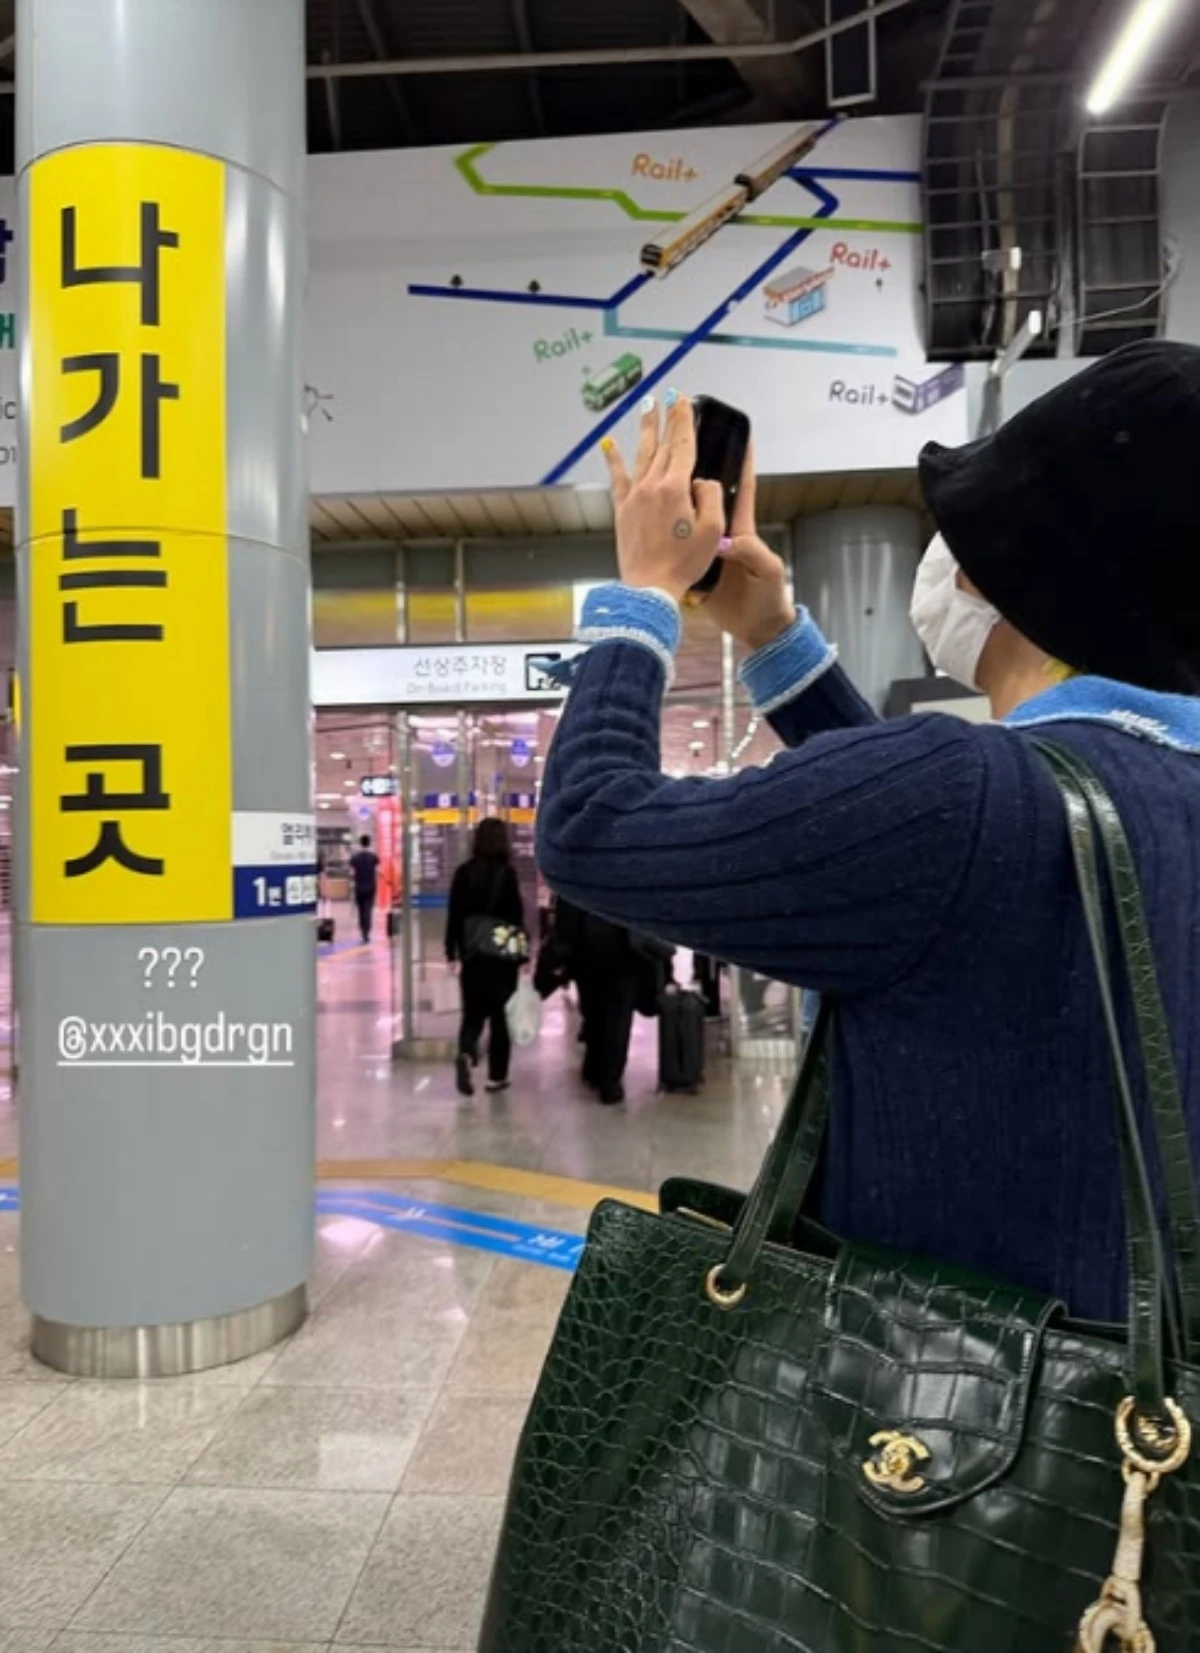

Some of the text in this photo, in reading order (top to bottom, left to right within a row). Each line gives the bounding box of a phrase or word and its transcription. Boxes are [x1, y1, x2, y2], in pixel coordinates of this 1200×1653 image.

[631, 152, 698, 184] Rail+
[830, 242, 892, 271] Rail+
[532, 326, 594, 363] Rail+
[829, 379, 889, 405] Rail+
[60, 202, 180, 878] 나가는 곳
